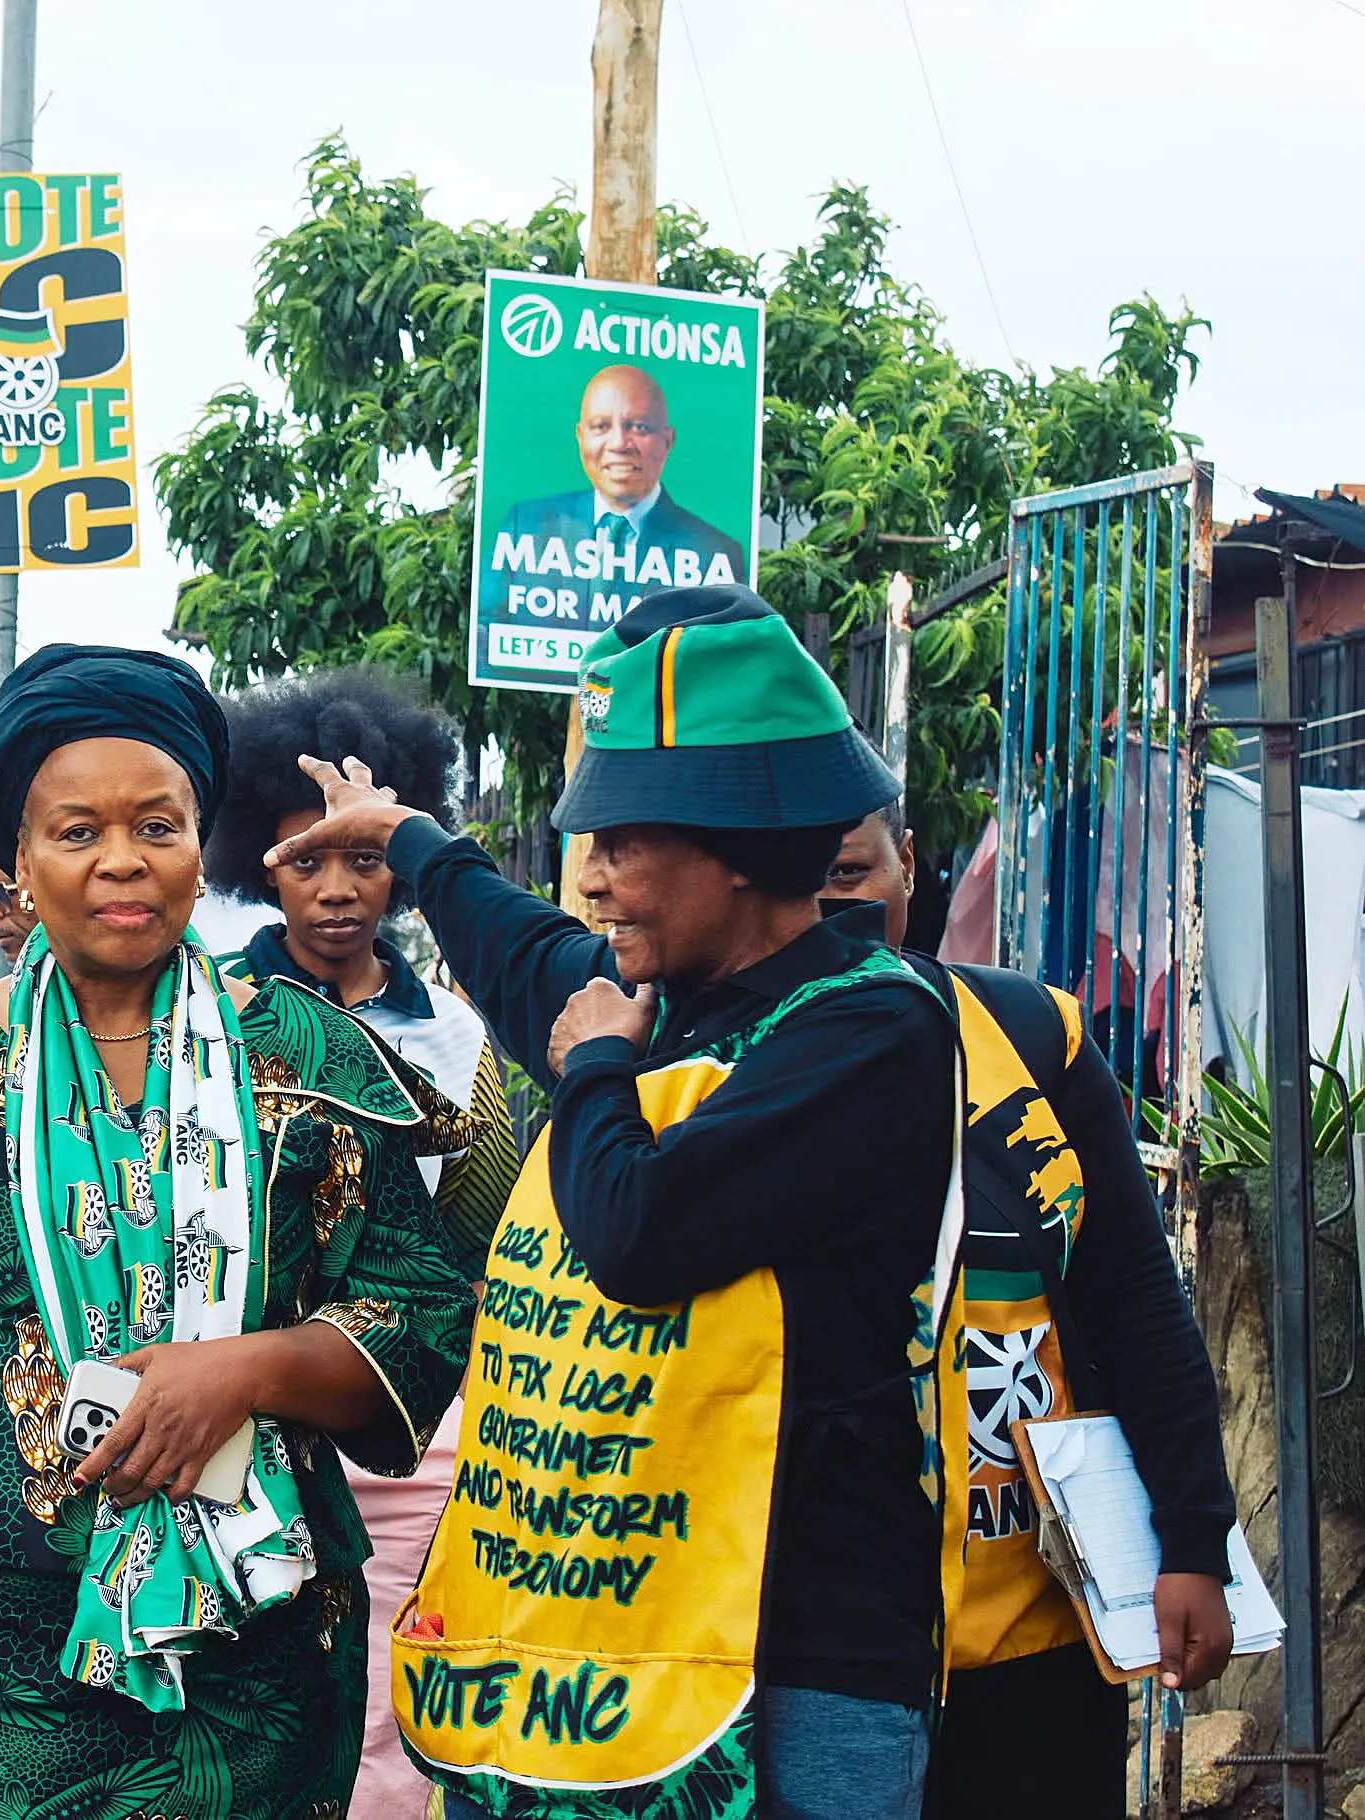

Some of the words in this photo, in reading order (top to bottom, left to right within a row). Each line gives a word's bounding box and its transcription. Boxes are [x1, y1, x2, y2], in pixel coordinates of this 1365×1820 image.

[574, 307, 745, 368] ACTIONSA
[492, 531, 735, 587] MASHABA
[508, 585, 579, 619] FOR
[499, 636, 558, 659] LET'S
[176, 1124, 188, 1166] ANC
[176, 1241, 188, 1289] ANC
[107, 1301, 121, 1349] ANC
[481, 1343, 502, 1385] TO
[508, 1354, 552, 1401] FIX
[259, 1431, 278, 1477] ANC
[454, 1459, 503, 1510] AND
[968, 1478, 1032, 1541] AN
[404, 1654, 521, 1729] VOTE
[521, 1657, 630, 1744] ANC
